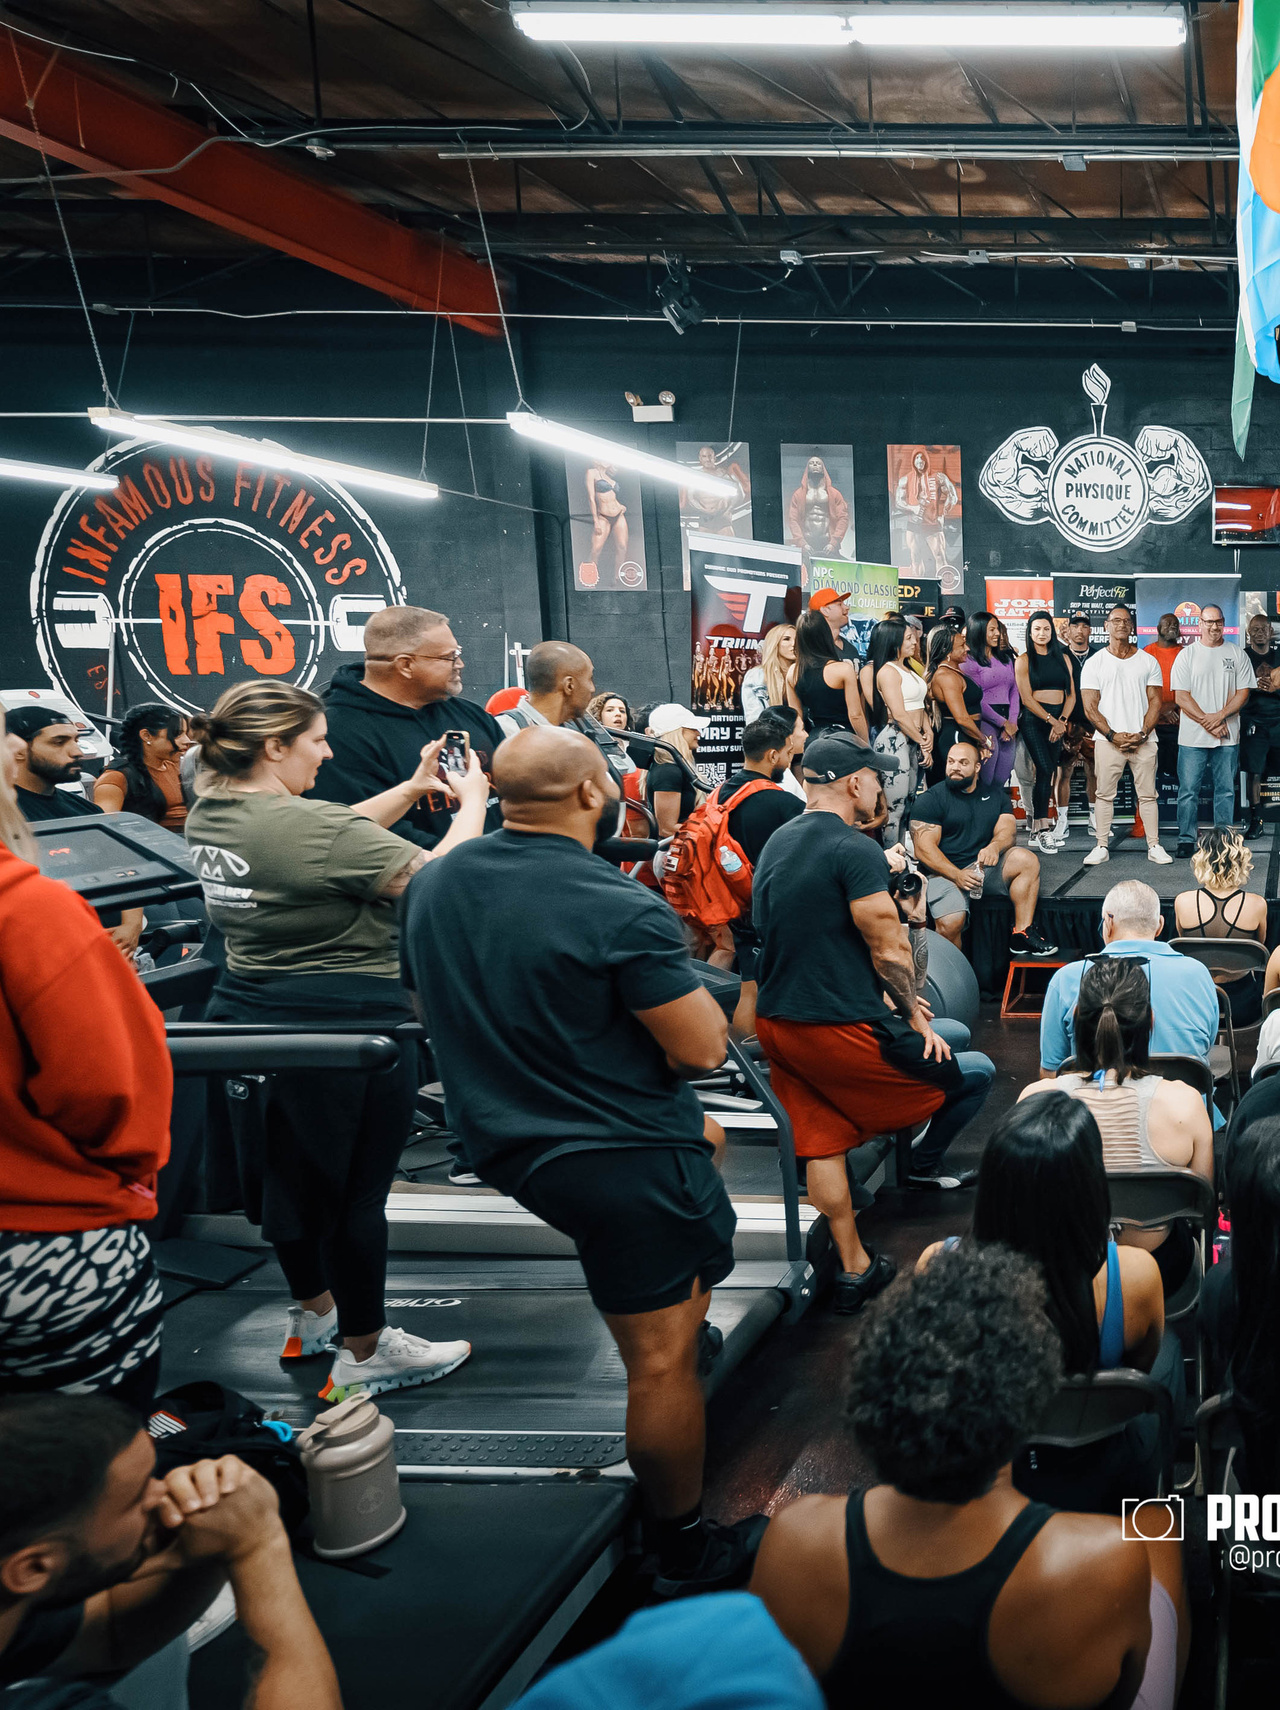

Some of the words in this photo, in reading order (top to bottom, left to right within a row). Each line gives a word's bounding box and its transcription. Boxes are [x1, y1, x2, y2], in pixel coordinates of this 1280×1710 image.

[1064, 451, 1132, 480] NATIONAL
[1065, 483, 1132, 501] PHYSIQUE
[62, 456, 215, 585] INFAMOUS
[233, 461, 367, 585] FITNESS
[1062, 504, 1135, 535] COMMITTEE
[813, 567, 834, 578] NPC
[813, 580, 860, 595] DIAMOND
[863, 583, 898, 597] CLASSIC
[858, 599, 897, 610] QUALIFIER
[994, 608, 1054, 617] GATT
[155, 574, 295, 675] IFS
[697, 727, 730, 740] MAY
